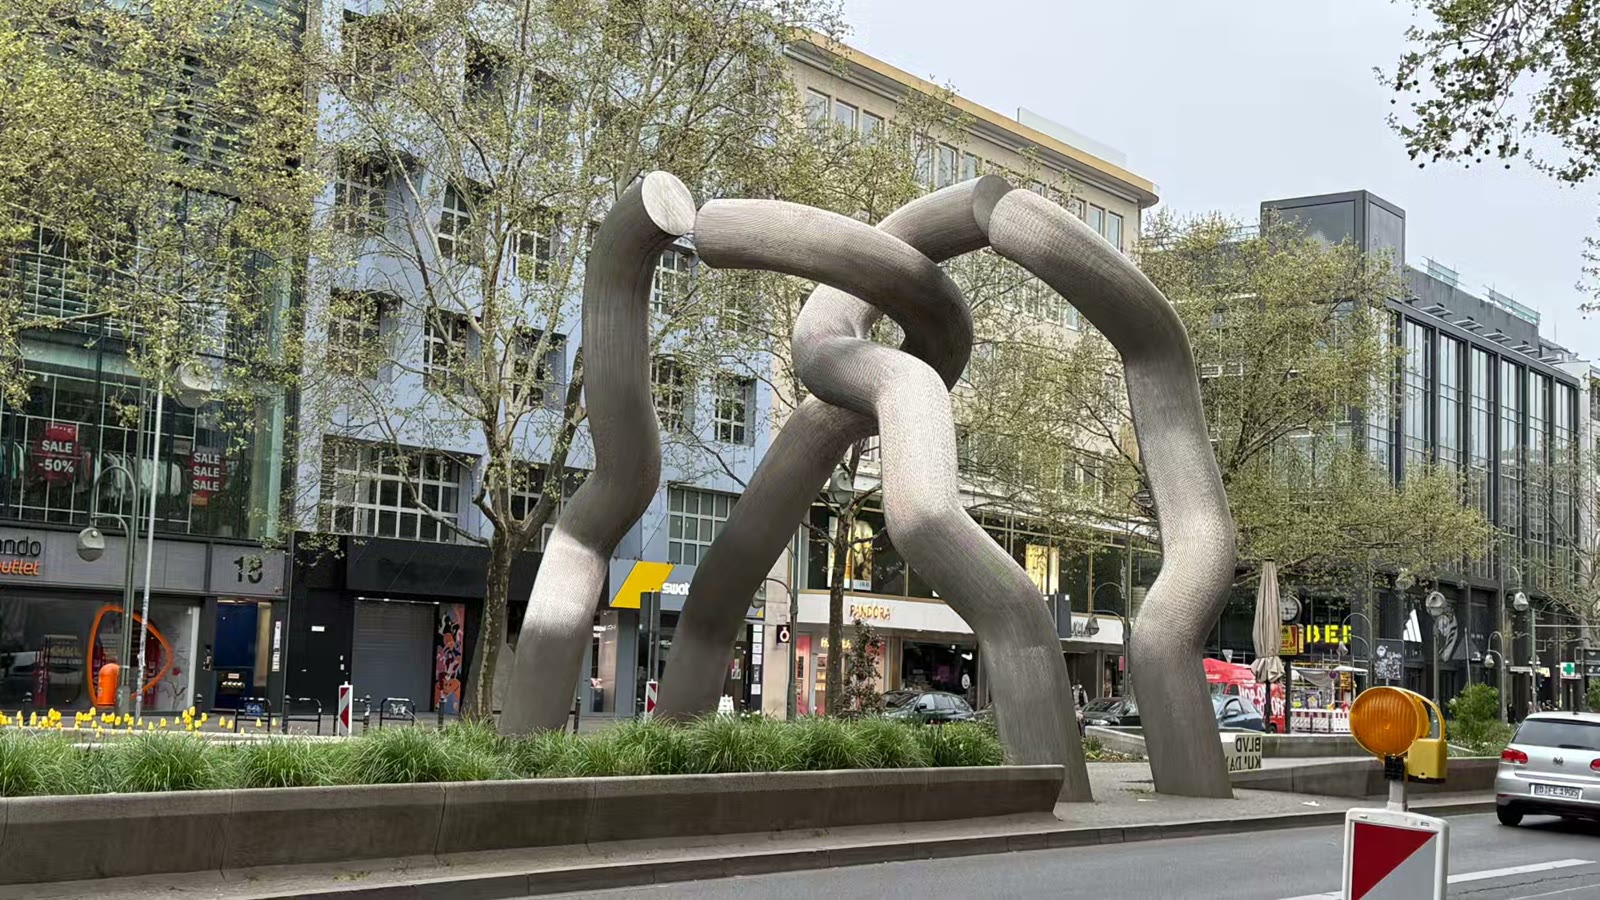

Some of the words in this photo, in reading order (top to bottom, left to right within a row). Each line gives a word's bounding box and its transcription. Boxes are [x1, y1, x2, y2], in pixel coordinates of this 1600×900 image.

[42, 440, 73, 453] SALE
[193, 452, 221, 465] SALE
[39, 459, 74, 473] -50%
[193, 466, 220, 478] SALE
[192, 480, 220, 492] SALE
[0, 559, 40, 576] utlet
[850, 604, 891, 620] PANDORA
